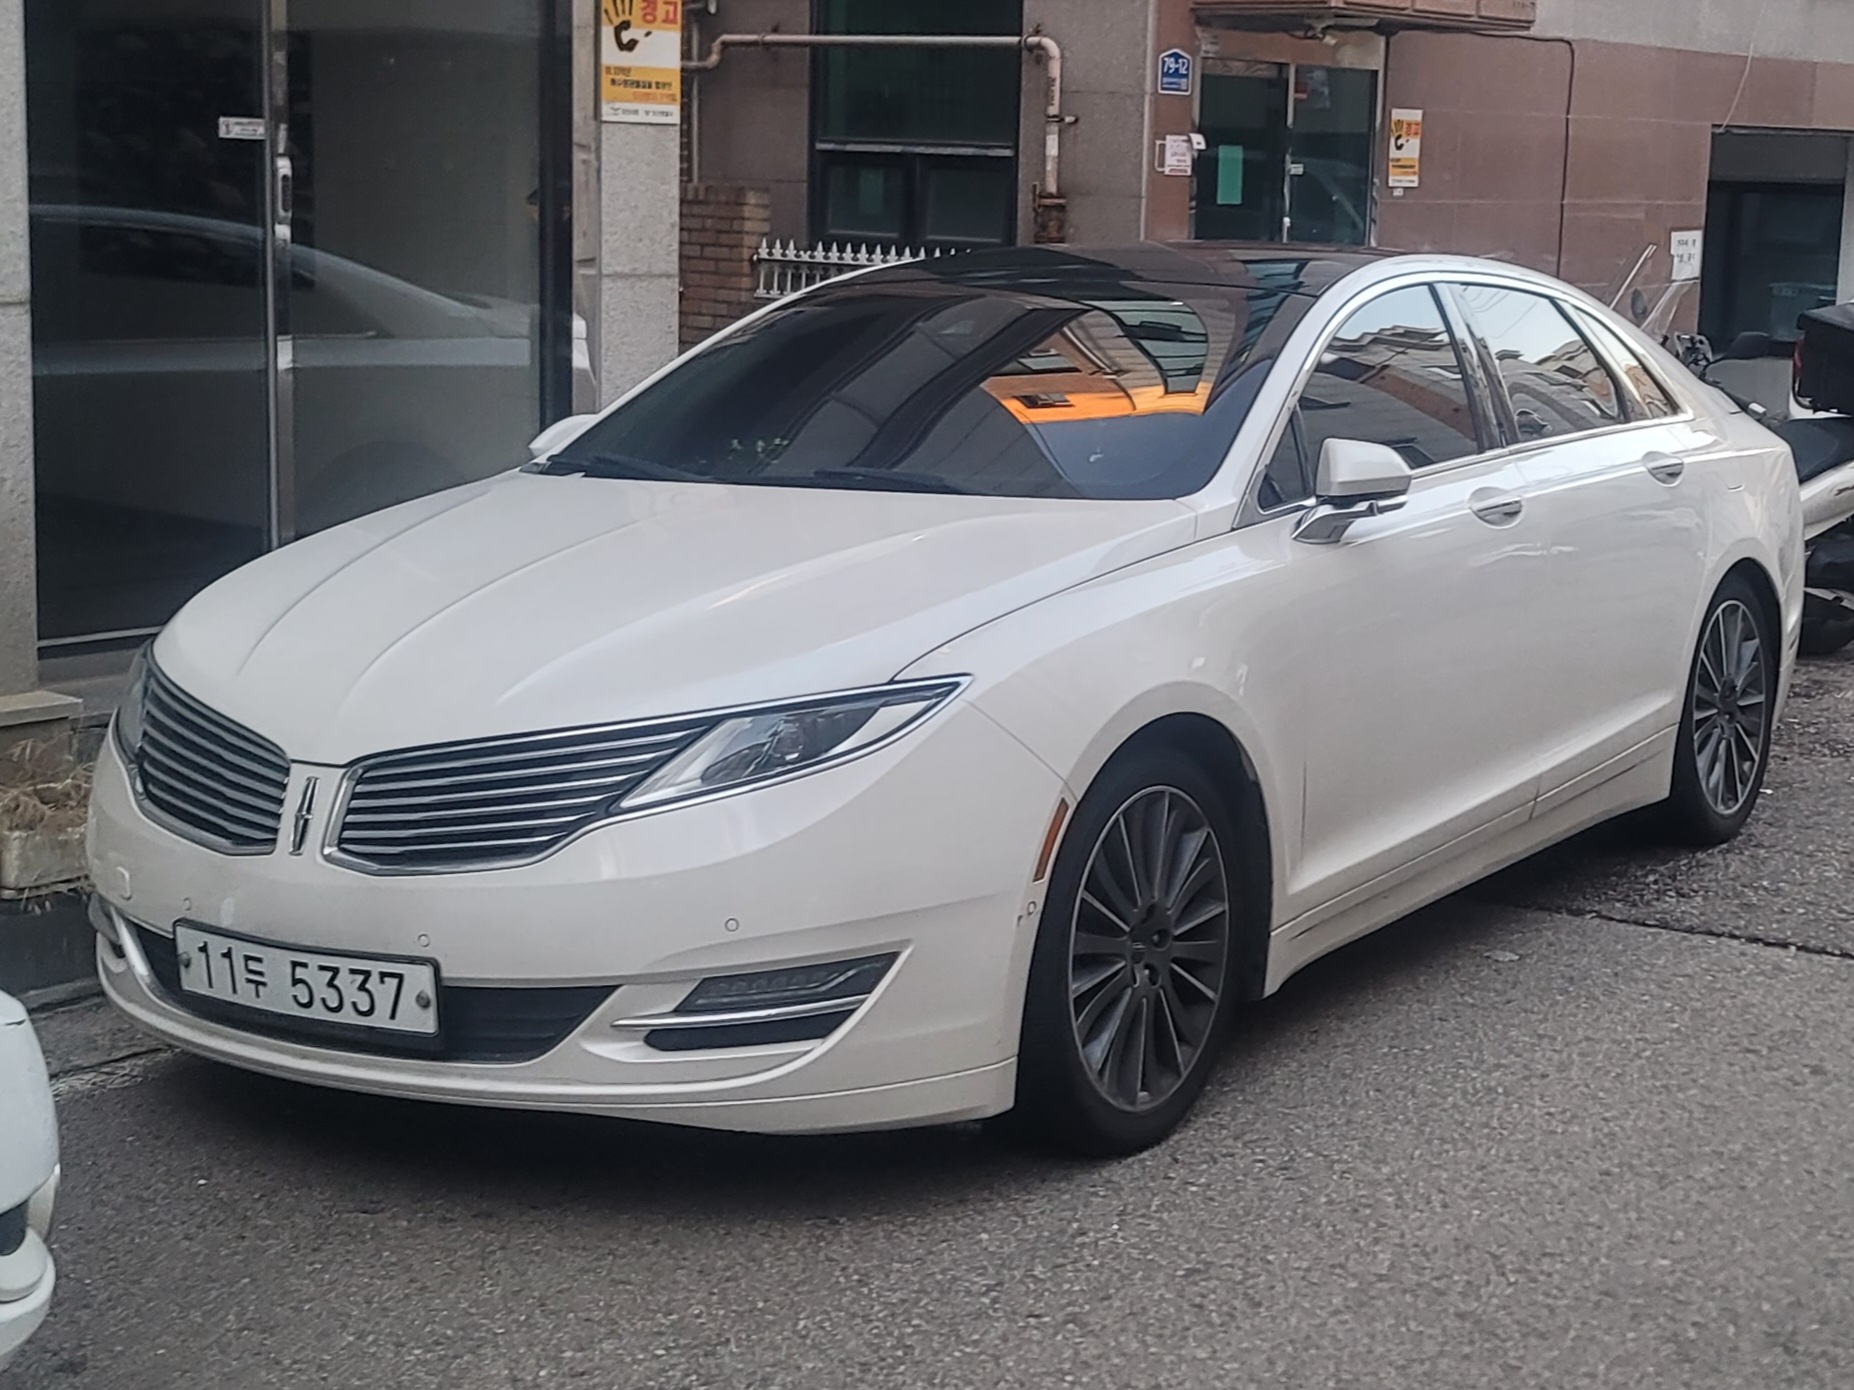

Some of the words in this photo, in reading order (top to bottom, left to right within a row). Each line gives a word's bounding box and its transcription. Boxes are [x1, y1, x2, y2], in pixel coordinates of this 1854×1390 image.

[641, 0, 678, 25] 경고
[1163, 58, 1188, 75] 79-12
[197, 940, 268, 999] 11두
[290, 959, 405, 1021] 5337
